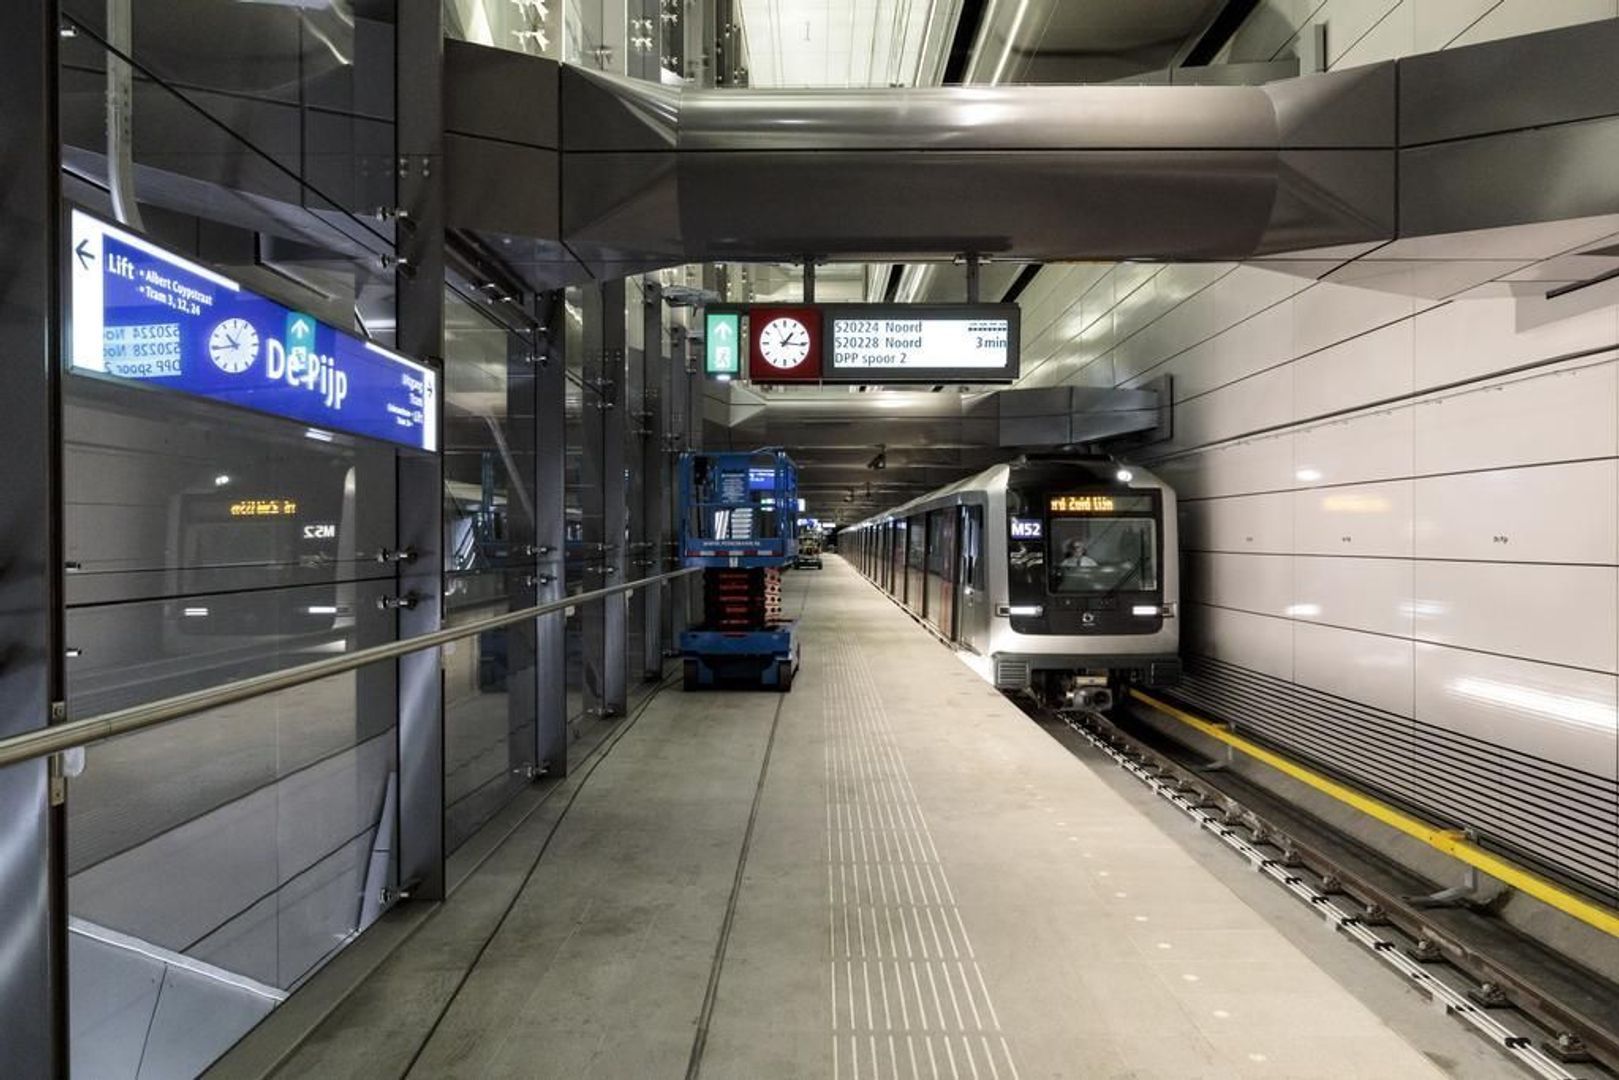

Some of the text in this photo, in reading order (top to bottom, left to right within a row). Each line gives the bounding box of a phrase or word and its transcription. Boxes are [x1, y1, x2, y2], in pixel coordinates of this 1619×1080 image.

[109, 253, 134, 280] Lift
[146, 270, 170, 291] Albert
[146, 286, 167, 304] Tram
[885, 321, 923, 333] Noord
[885, 337, 923, 349] Noord
[835, 352, 908, 366] DPP spoor 2
[306, 351, 348, 410] Pijp
[1011, 523, 1041, 536] M52
